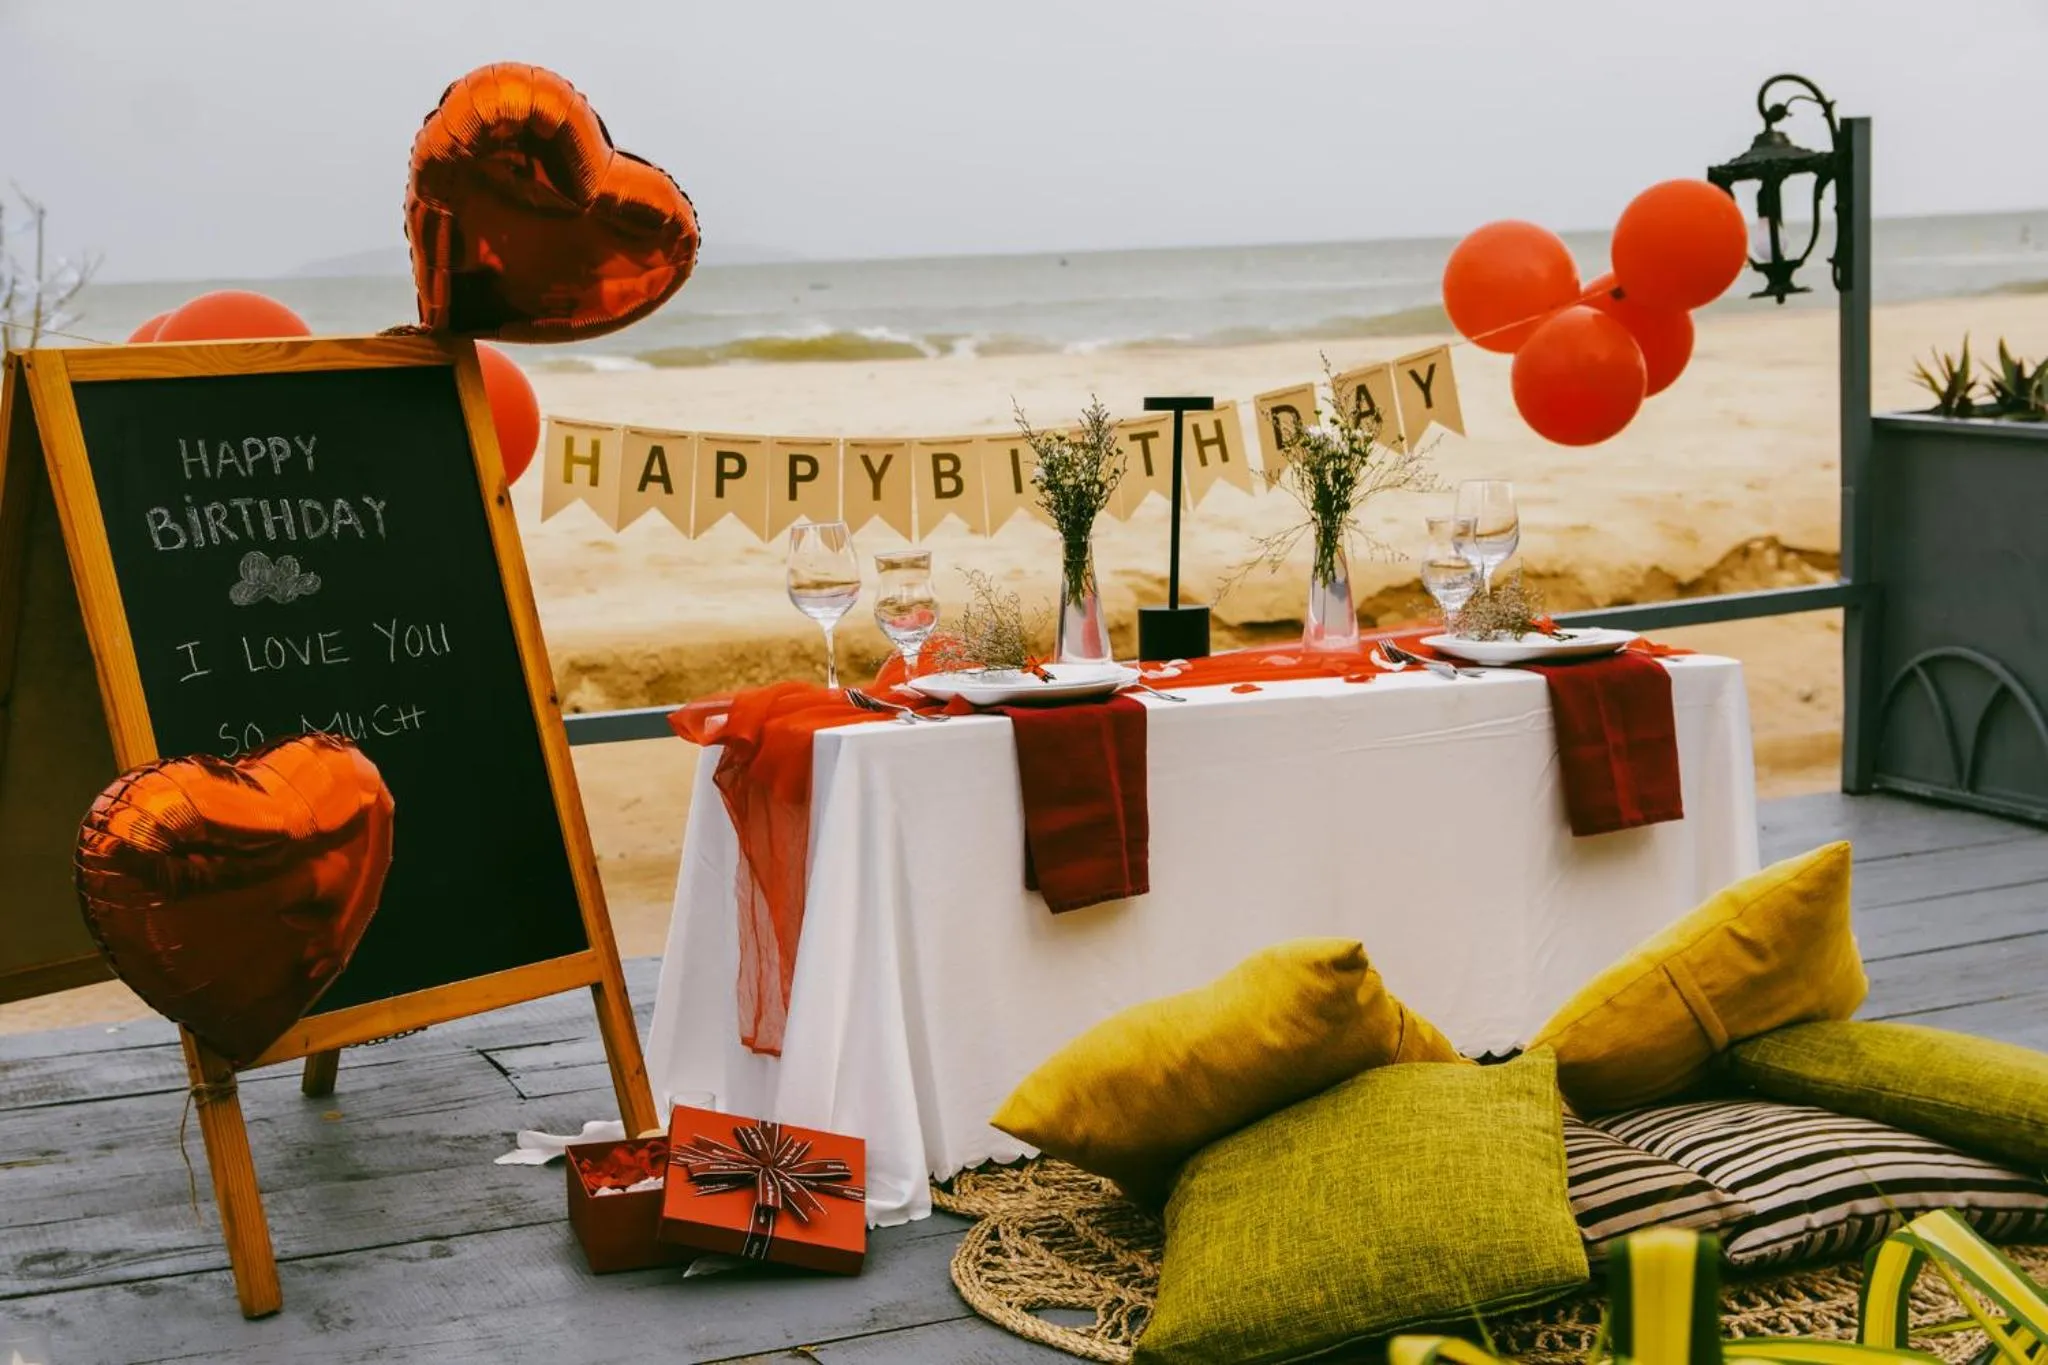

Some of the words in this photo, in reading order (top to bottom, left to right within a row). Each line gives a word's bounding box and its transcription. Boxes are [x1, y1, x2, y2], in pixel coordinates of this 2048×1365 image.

[178, 434, 317, 479] HAPPY
[175, 640, 213, 682] I
[242, 630, 350, 672] LOVE
[373, 618, 451, 663] YOU
[300, 703, 426, 740] MUCH
